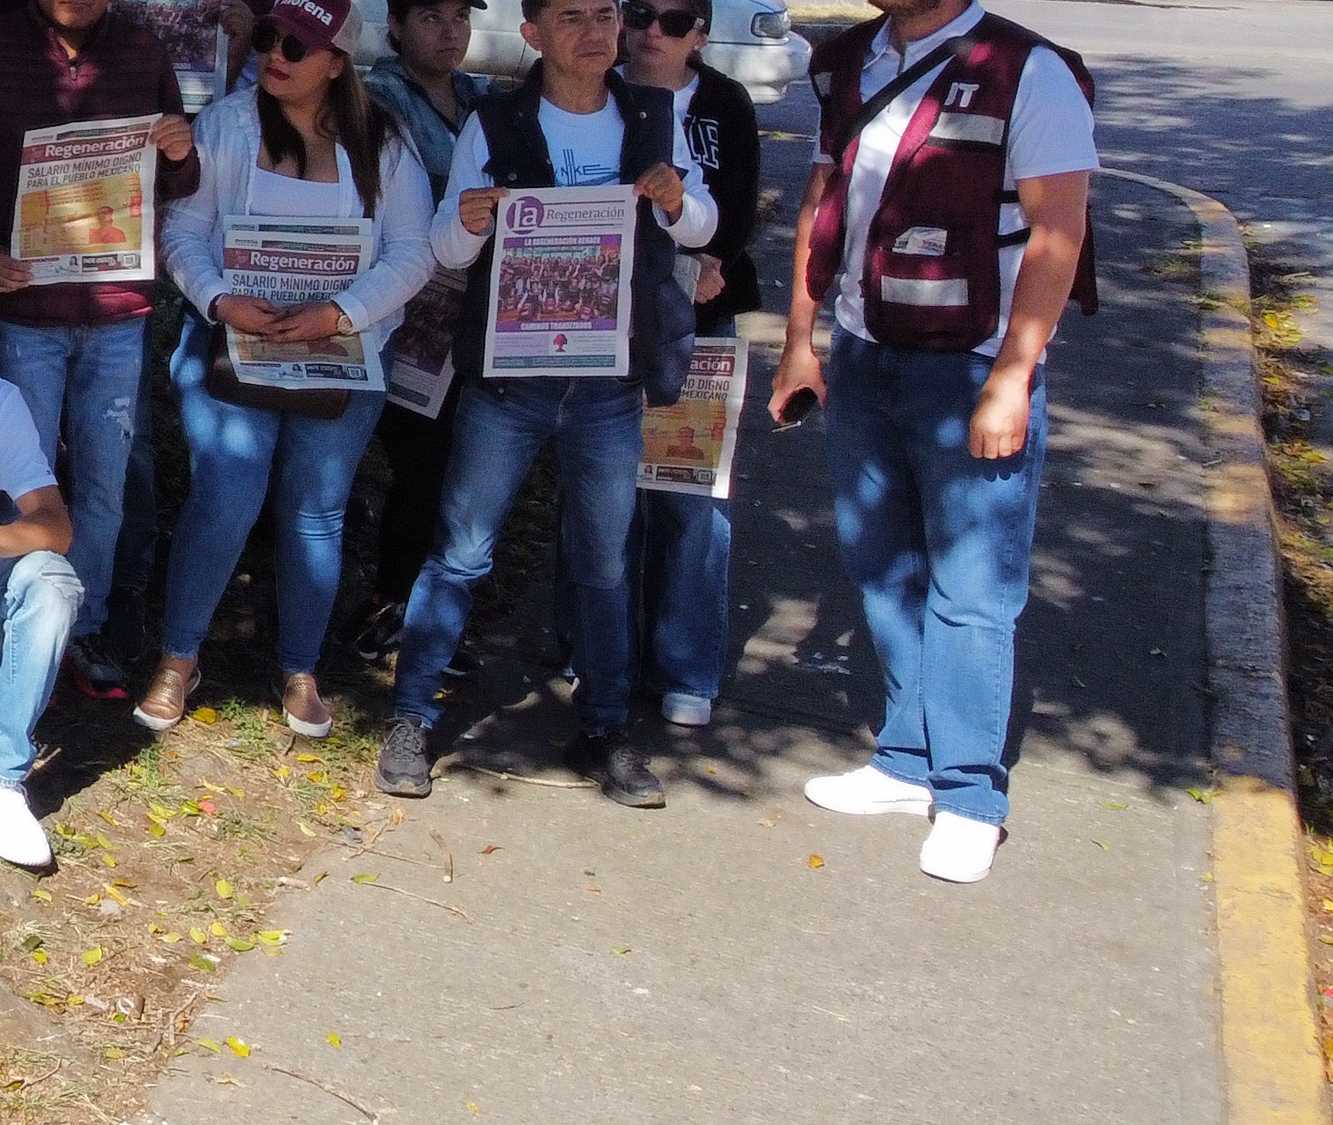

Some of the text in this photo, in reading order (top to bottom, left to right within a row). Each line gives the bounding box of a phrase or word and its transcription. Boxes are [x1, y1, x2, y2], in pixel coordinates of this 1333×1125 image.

[44, 132, 145, 159] Regeneración
[27, 151, 142, 179] SALARIO MÍNIMO DIGNO
[26, 162, 141, 189] PARA EL PUEBLO MEXICANO
[546, 206, 625, 223] Regeneración
[249, 250, 355, 272] Regeneración
[232, 273, 277, 290] SALARIO
[279, 274, 320, 291] MÍNIMO
[269, 290, 306, 302] PUEBLO
[697, 378, 731, 392] DIGNO
